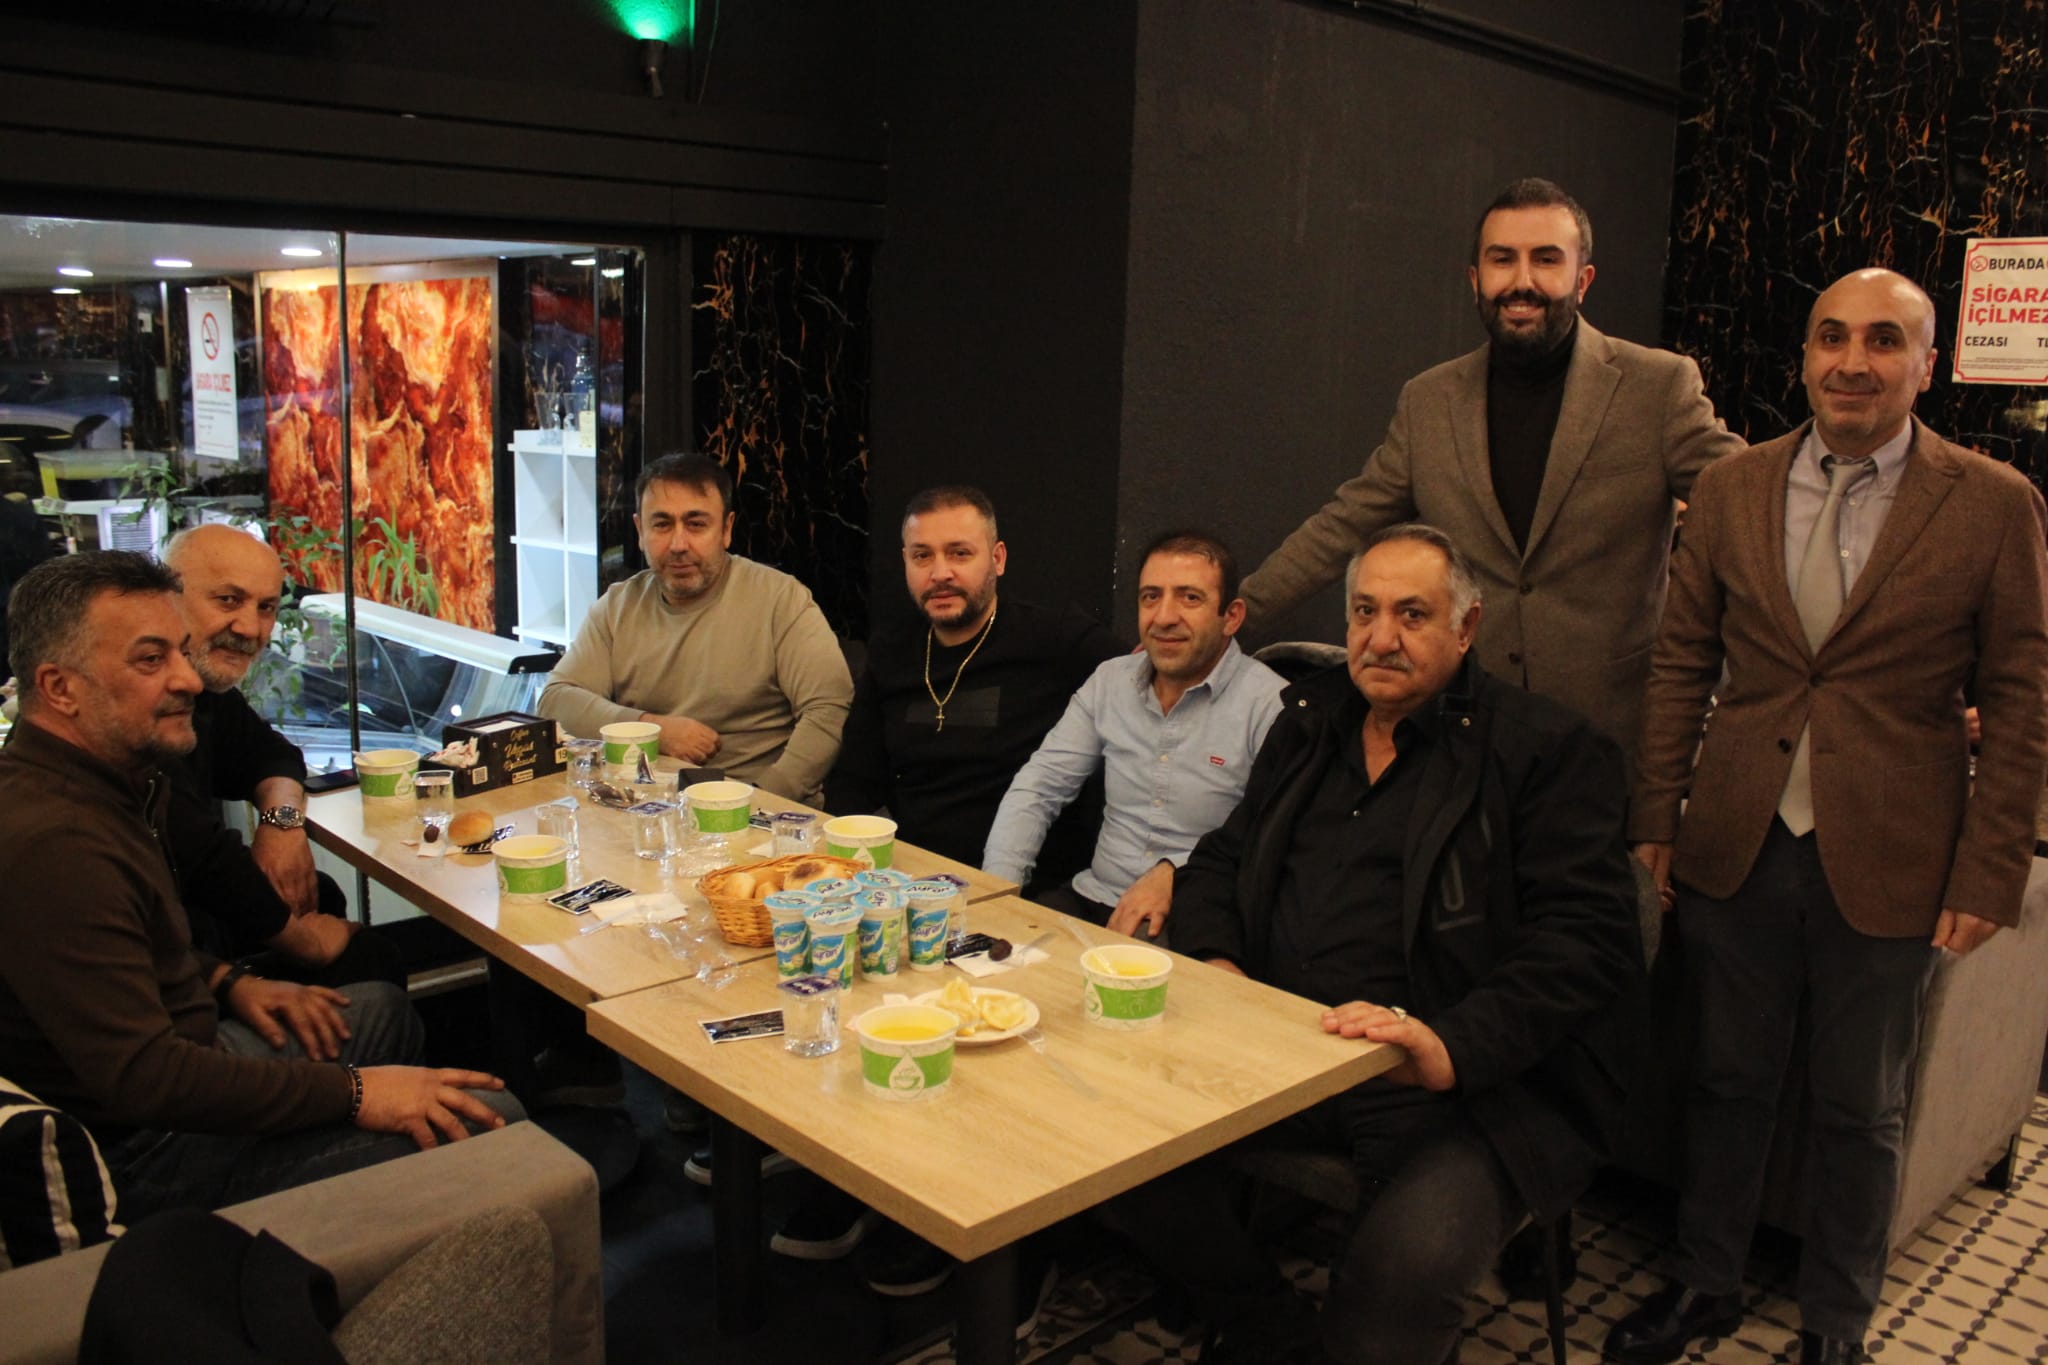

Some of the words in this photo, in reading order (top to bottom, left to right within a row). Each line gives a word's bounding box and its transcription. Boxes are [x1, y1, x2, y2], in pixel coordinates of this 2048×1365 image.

[1988, 258, 2045, 270] BURADA
[1971, 283, 2048, 303] SİGARA
[1964, 336, 2008, 347] CEZASI
[915, 923, 943, 937] Ayran
